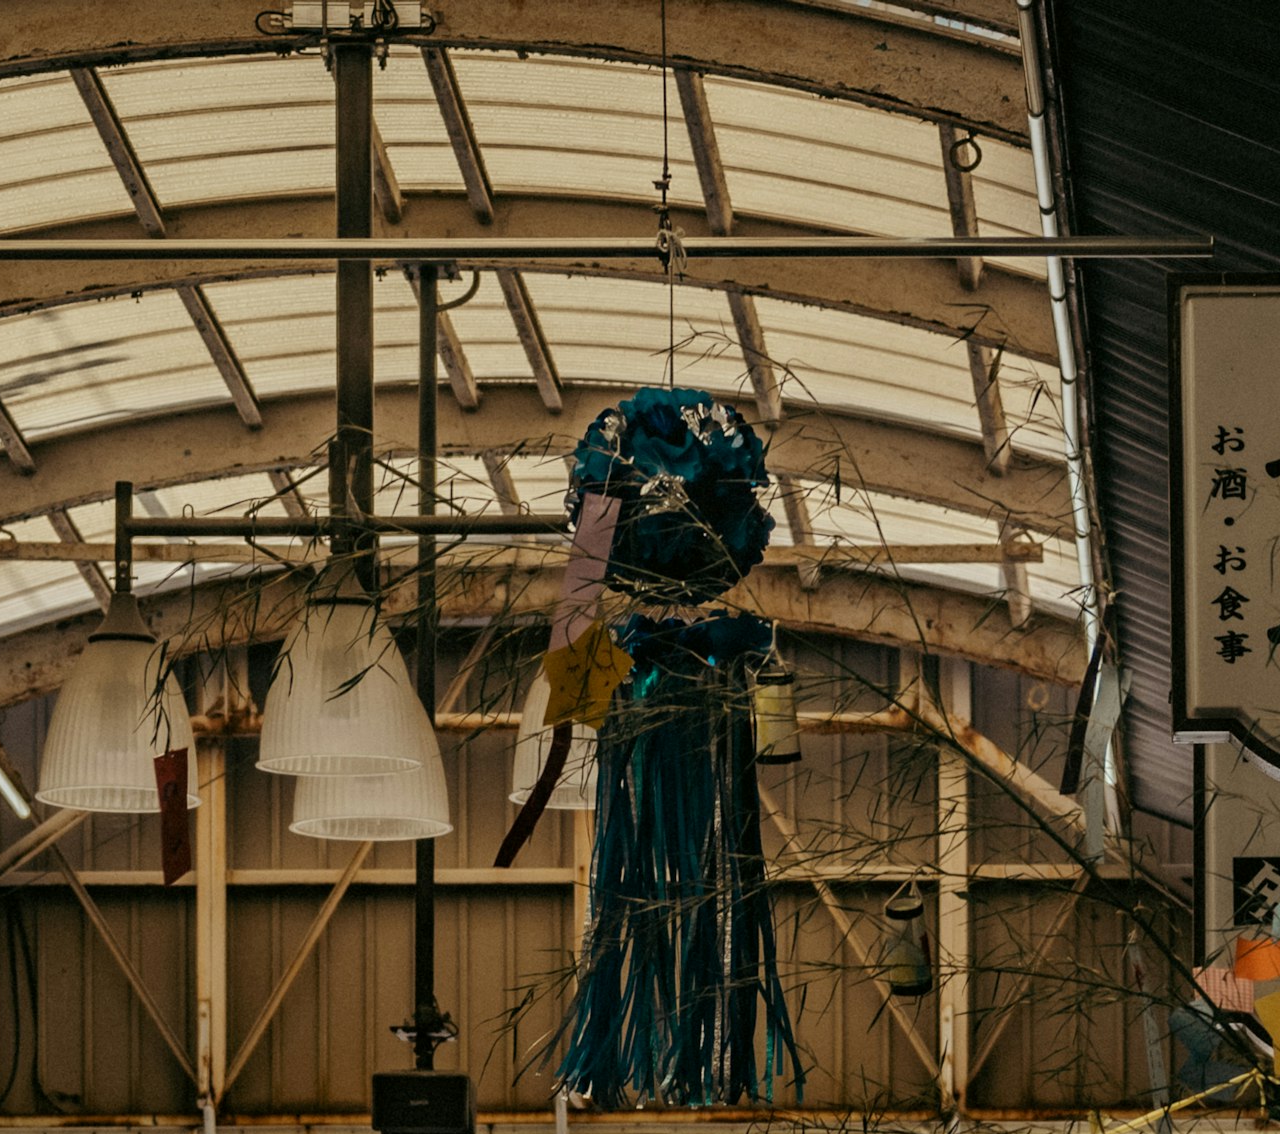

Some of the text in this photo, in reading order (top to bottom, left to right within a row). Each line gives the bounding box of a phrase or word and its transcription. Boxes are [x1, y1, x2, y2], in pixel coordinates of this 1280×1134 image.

[1210, 424, 1252, 664] お酒・お食事
